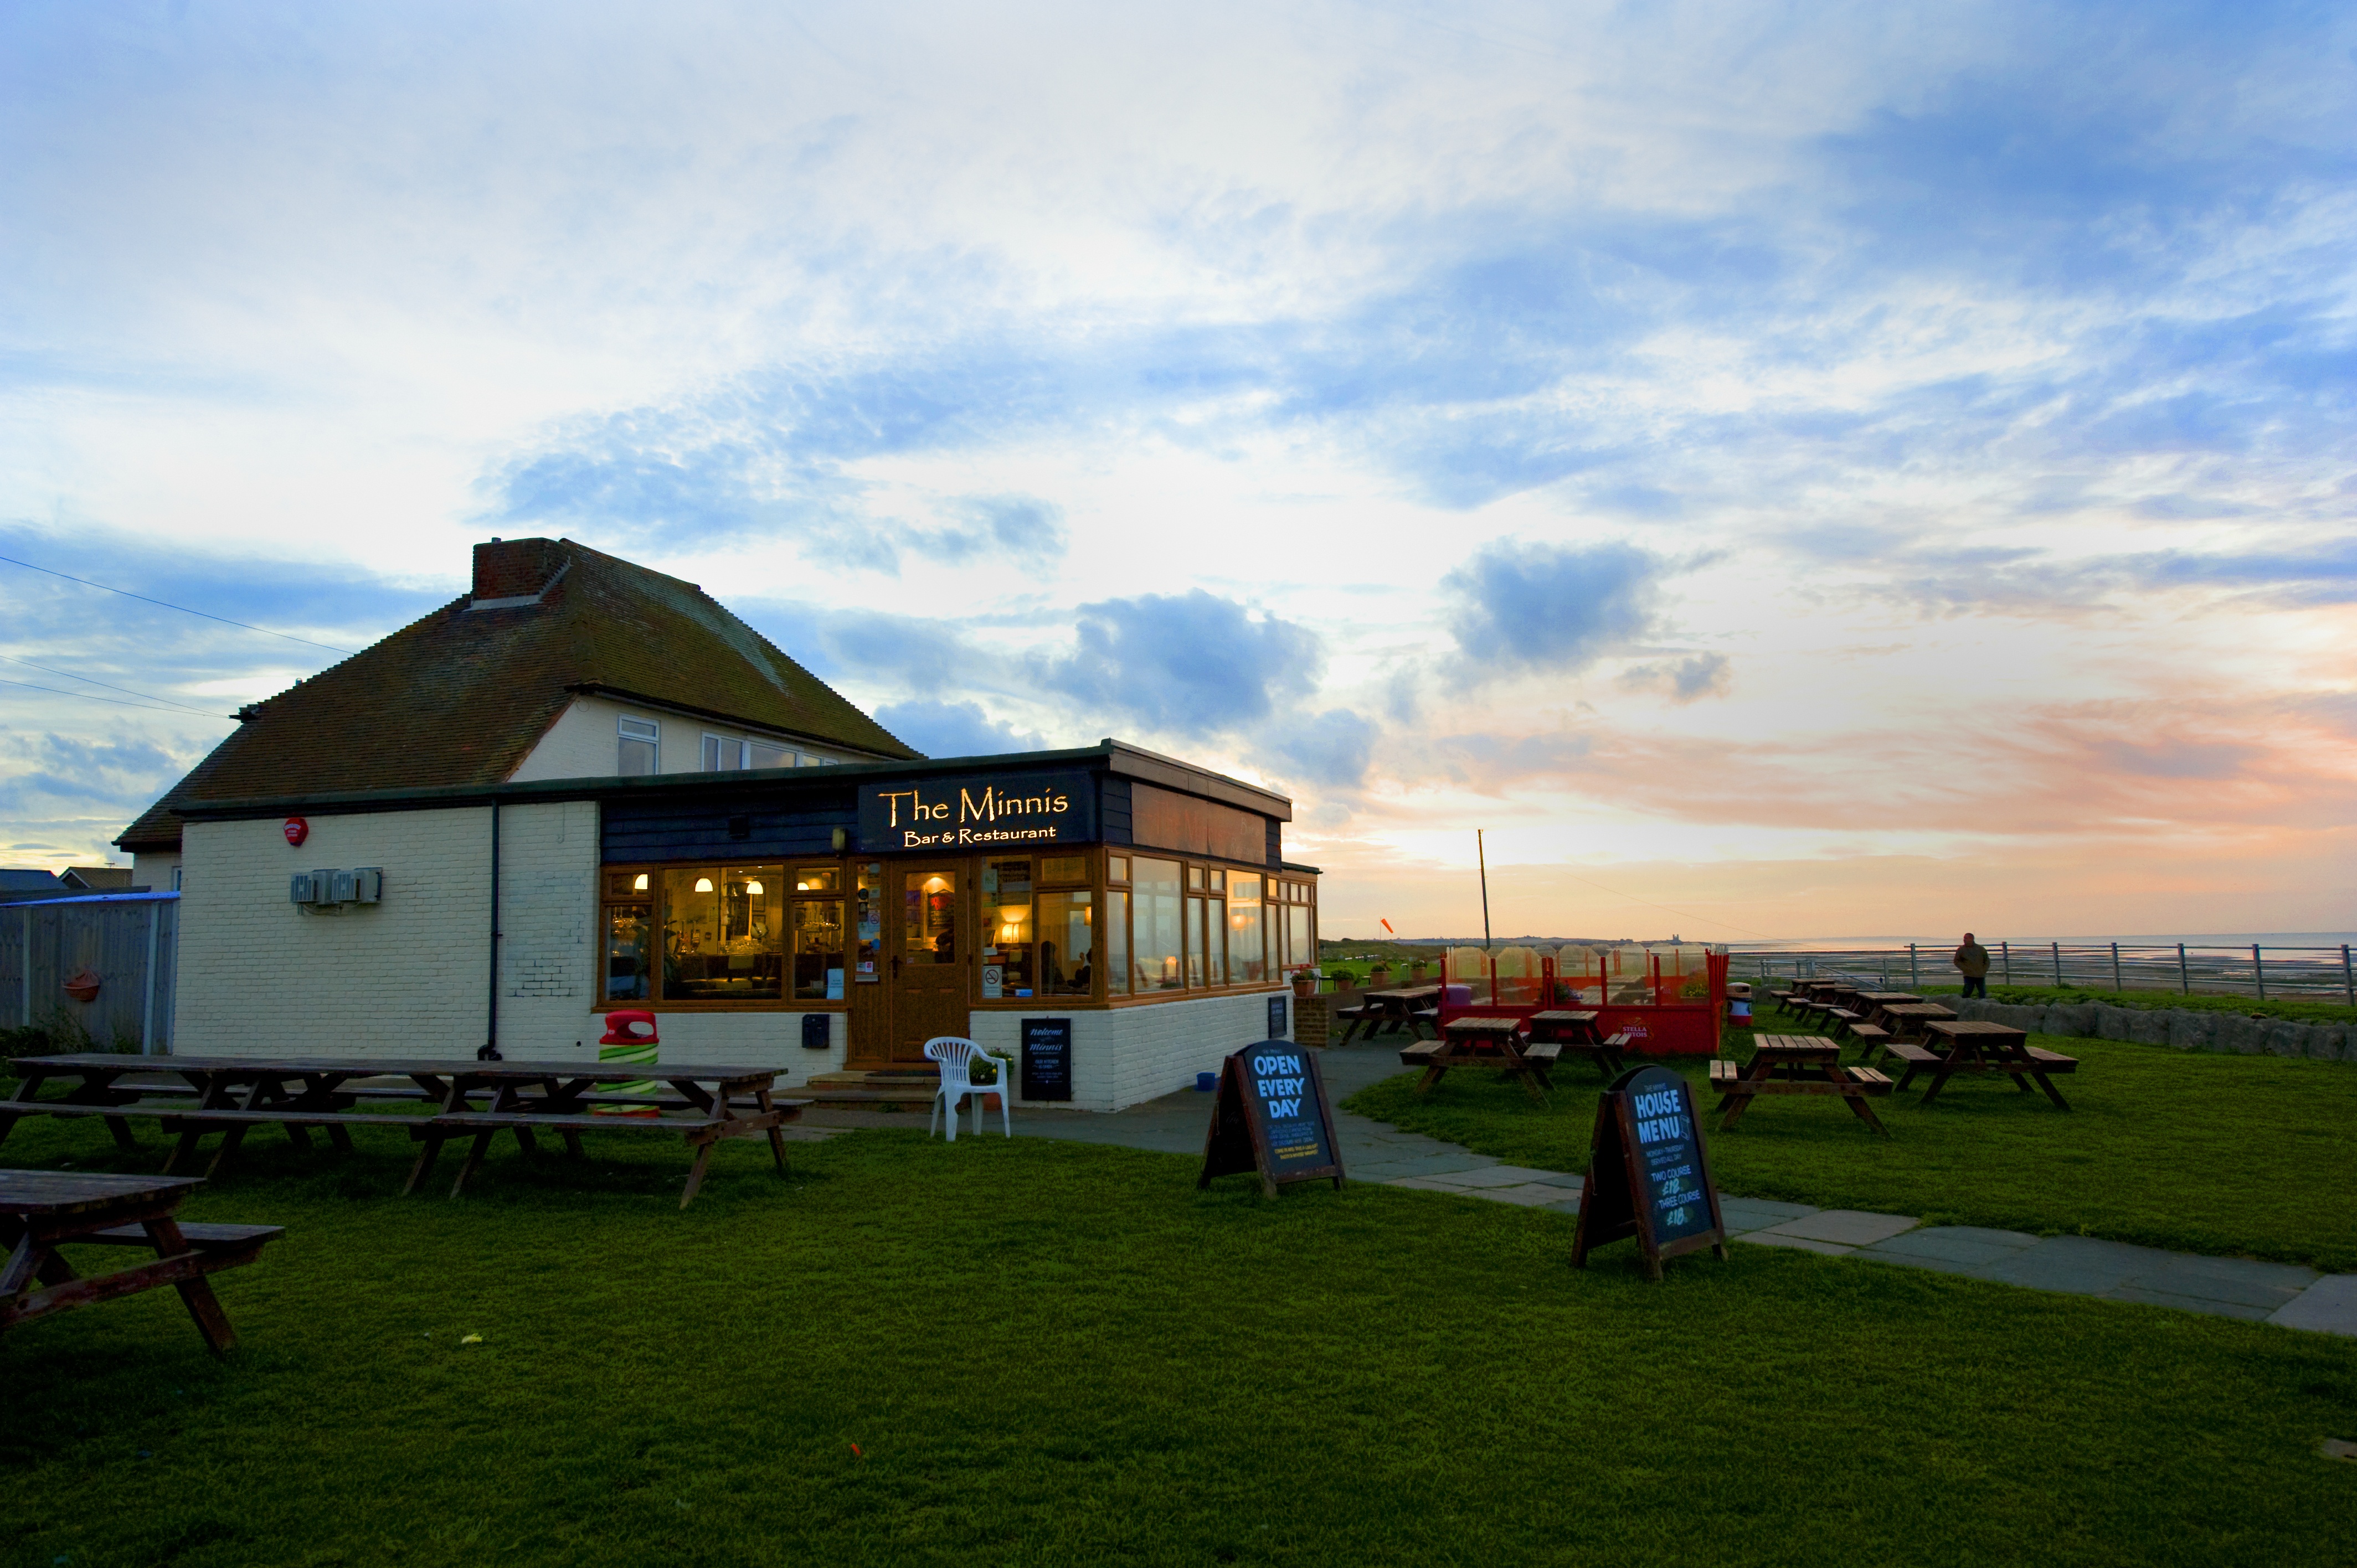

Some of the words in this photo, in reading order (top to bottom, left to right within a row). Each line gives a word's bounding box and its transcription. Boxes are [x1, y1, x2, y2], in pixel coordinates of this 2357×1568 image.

[878, 789, 949, 828] The
[960, 786, 1069, 823] Minnis
[904, 831, 939, 848] Bar
[942, 832, 955, 844] &
[959, 826, 1056, 844] Restaurant
[1254, 1055, 1301, 1076] OPEN
[1257, 1077, 1305, 1097] EVERY
[1268, 1098, 1301, 1118] DAY
[1635, 1089, 1681, 1118] HOUSE
[1638, 1116, 1680, 1143] MENU
[1651, 1170, 1666, 1182] TWO
[1667, 1164, 1692, 1179] COURSE
[1658, 1195, 1678, 1210] THREE
[1678, 1189, 1701, 1204] COURSE
